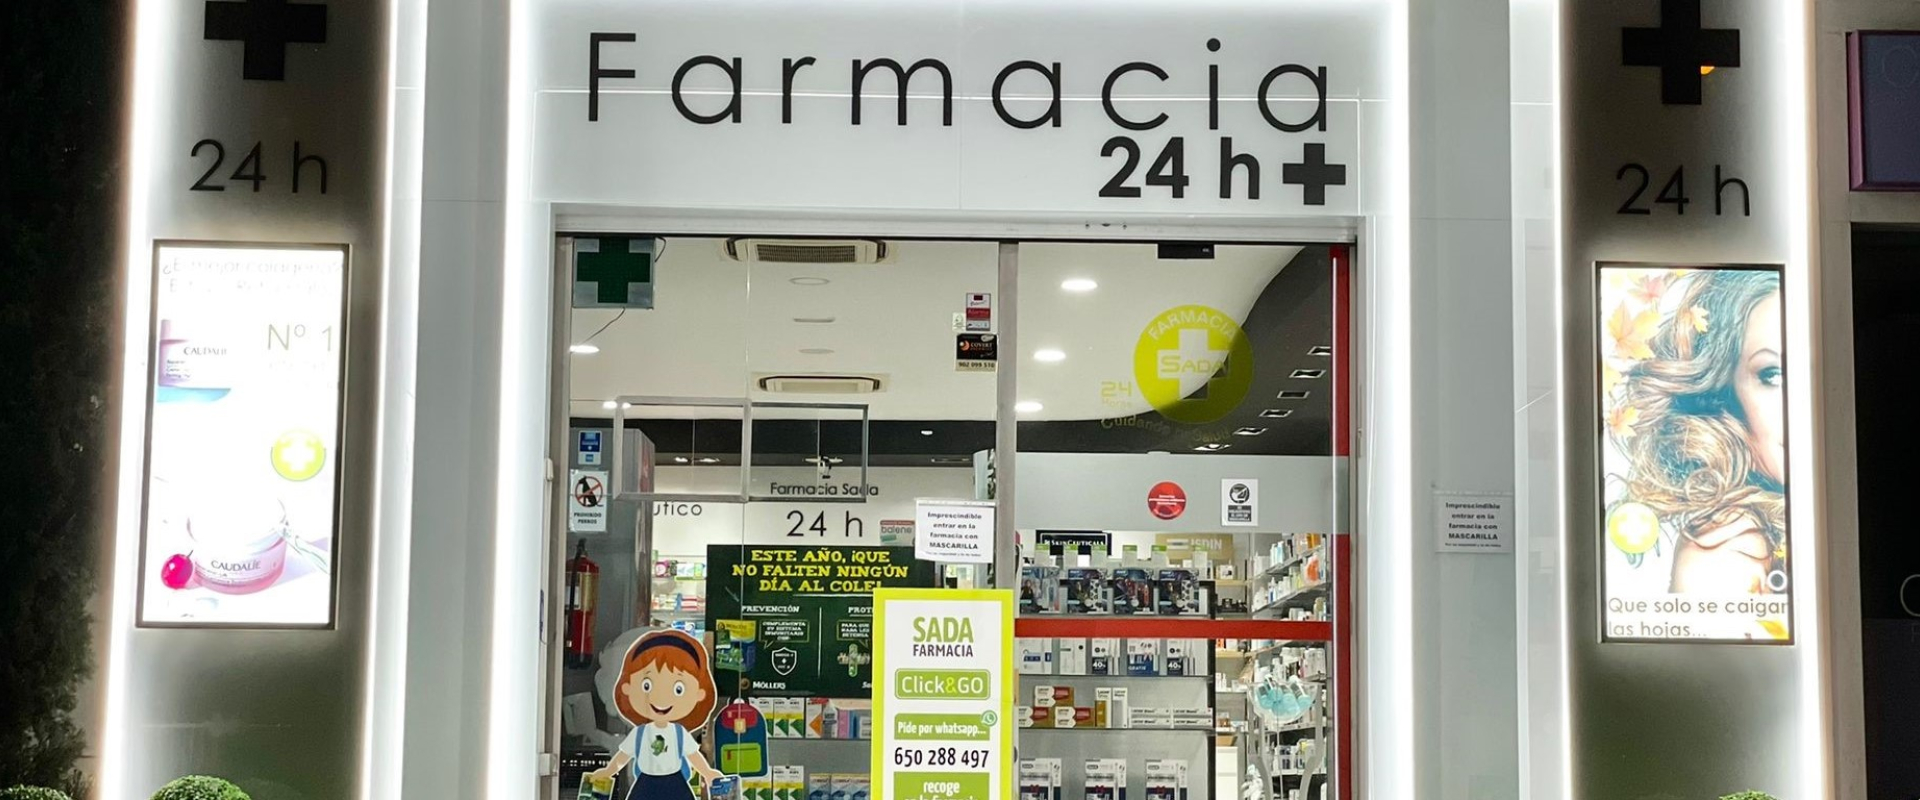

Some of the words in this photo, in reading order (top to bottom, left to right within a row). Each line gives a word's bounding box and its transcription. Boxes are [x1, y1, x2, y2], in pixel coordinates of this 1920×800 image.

[588, 32, 1327, 133] Farmacia
[191, 139, 267, 193] 24
[291, 137, 330, 194] h
[1098, 136, 1190, 199] 24
[1219, 136, 1260, 200] h
[1616, 163, 1690, 217] 24
[1715, 164, 1751, 217] h
[1149, 309, 1236, 341] FARMACIA
[322, 325, 332, 352] 1
[1101, 381, 1132, 397] 24
[770, 482, 837, 496] Farmacia
[1445, 502, 1501, 510] Imprescindible
[927, 511, 982, 520] Imprescindible
[786, 510, 827, 537] 24
[845, 510, 863, 538] h
[933, 522, 956, 530] entrar
[1448, 522, 1482, 530] farmacia
[930, 532, 963, 540] farmacia
[1448, 533, 1499, 541] MASCARILLA
[929, 542, 979, 550] MASCARILLA
[751, 549, 797, 562] ESTE
[802, 547, 846, 564] AÑO,
[732, 564, 758, 577] NO
[762, 564, 831, 578] FALTEN
[836, 563, 909, 578] NINGÚN
[758, 577, 793, 592] DÍA
[800, 580, 824, 592] AL
[742, 604, 800, 613] PREVENCIÓN
[1608, 597, 1648, 614] Que
[1654, 598, 1692, 614] solo
[1699, 601, 1718, 614] se
[912, 616, 974, 643] SADA
[1608, 621, 1634, 637] las
[912, 644, 974, 658] FARMACIA
[901, 676, 984, 694] Click&GO
[897, 721, 917, 734] Pide
[918, 724, 933, 737] por
[894, 747, 923, 767] 650
[928, 747, 956, 766] 288
[961, 750, 989, 768] 497
[923, 781, 960, 796] recoge
